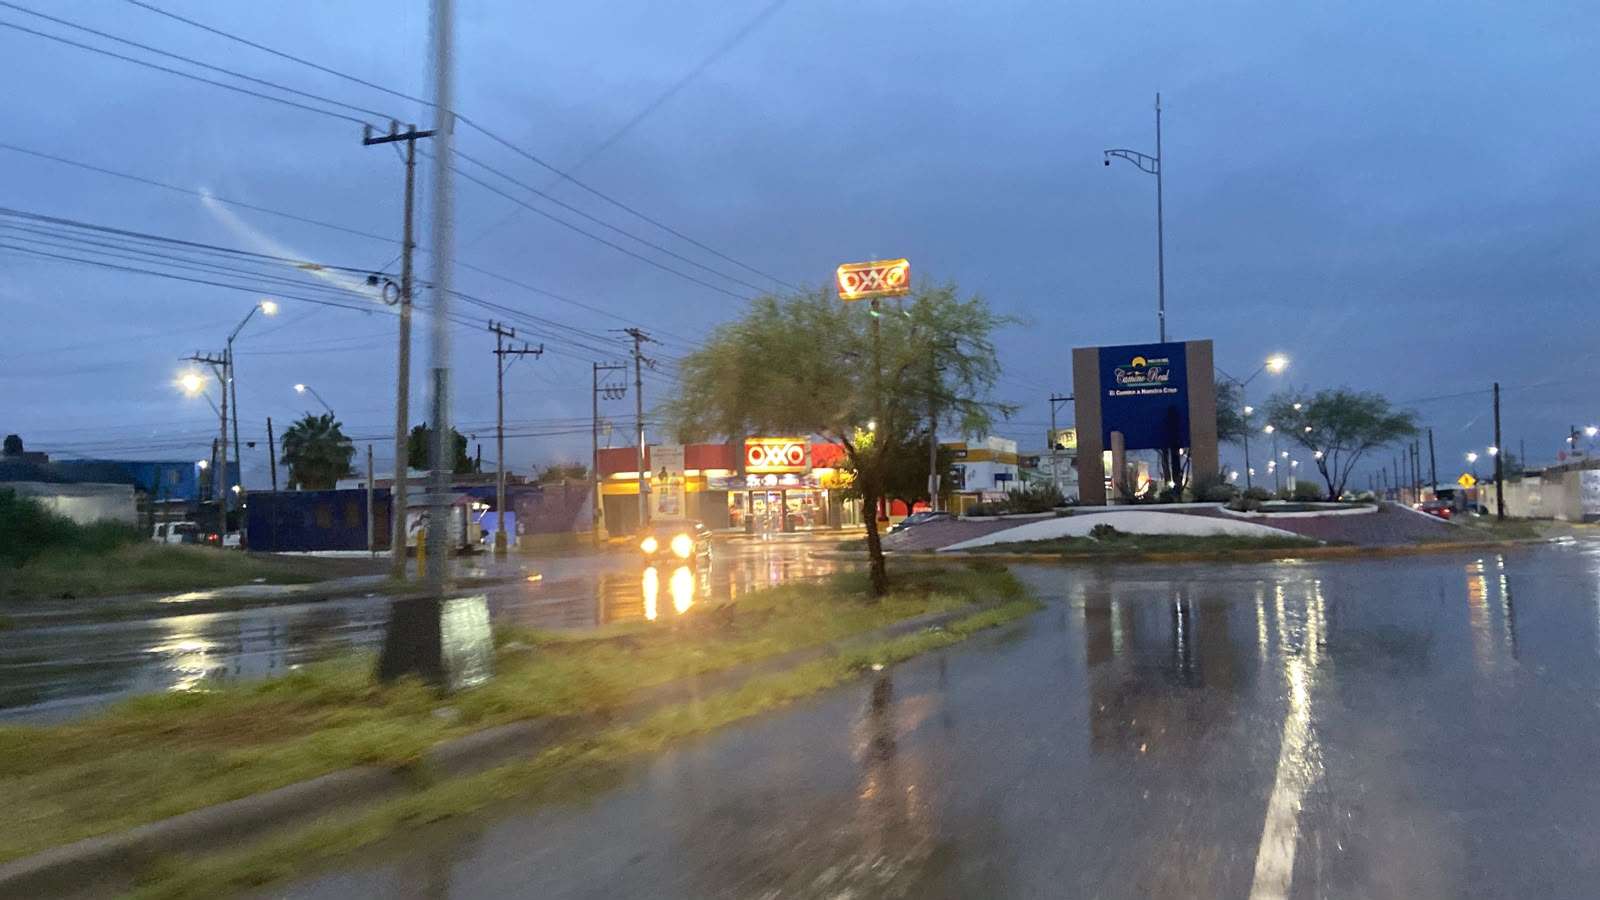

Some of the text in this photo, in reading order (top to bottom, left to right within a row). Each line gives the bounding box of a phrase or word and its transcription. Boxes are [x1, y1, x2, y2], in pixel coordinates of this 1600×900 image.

[839, 267, 906, 295] OXXO
[1147, 367, 1169, 382] Real
[748, 444, 804, 466] OXXO
